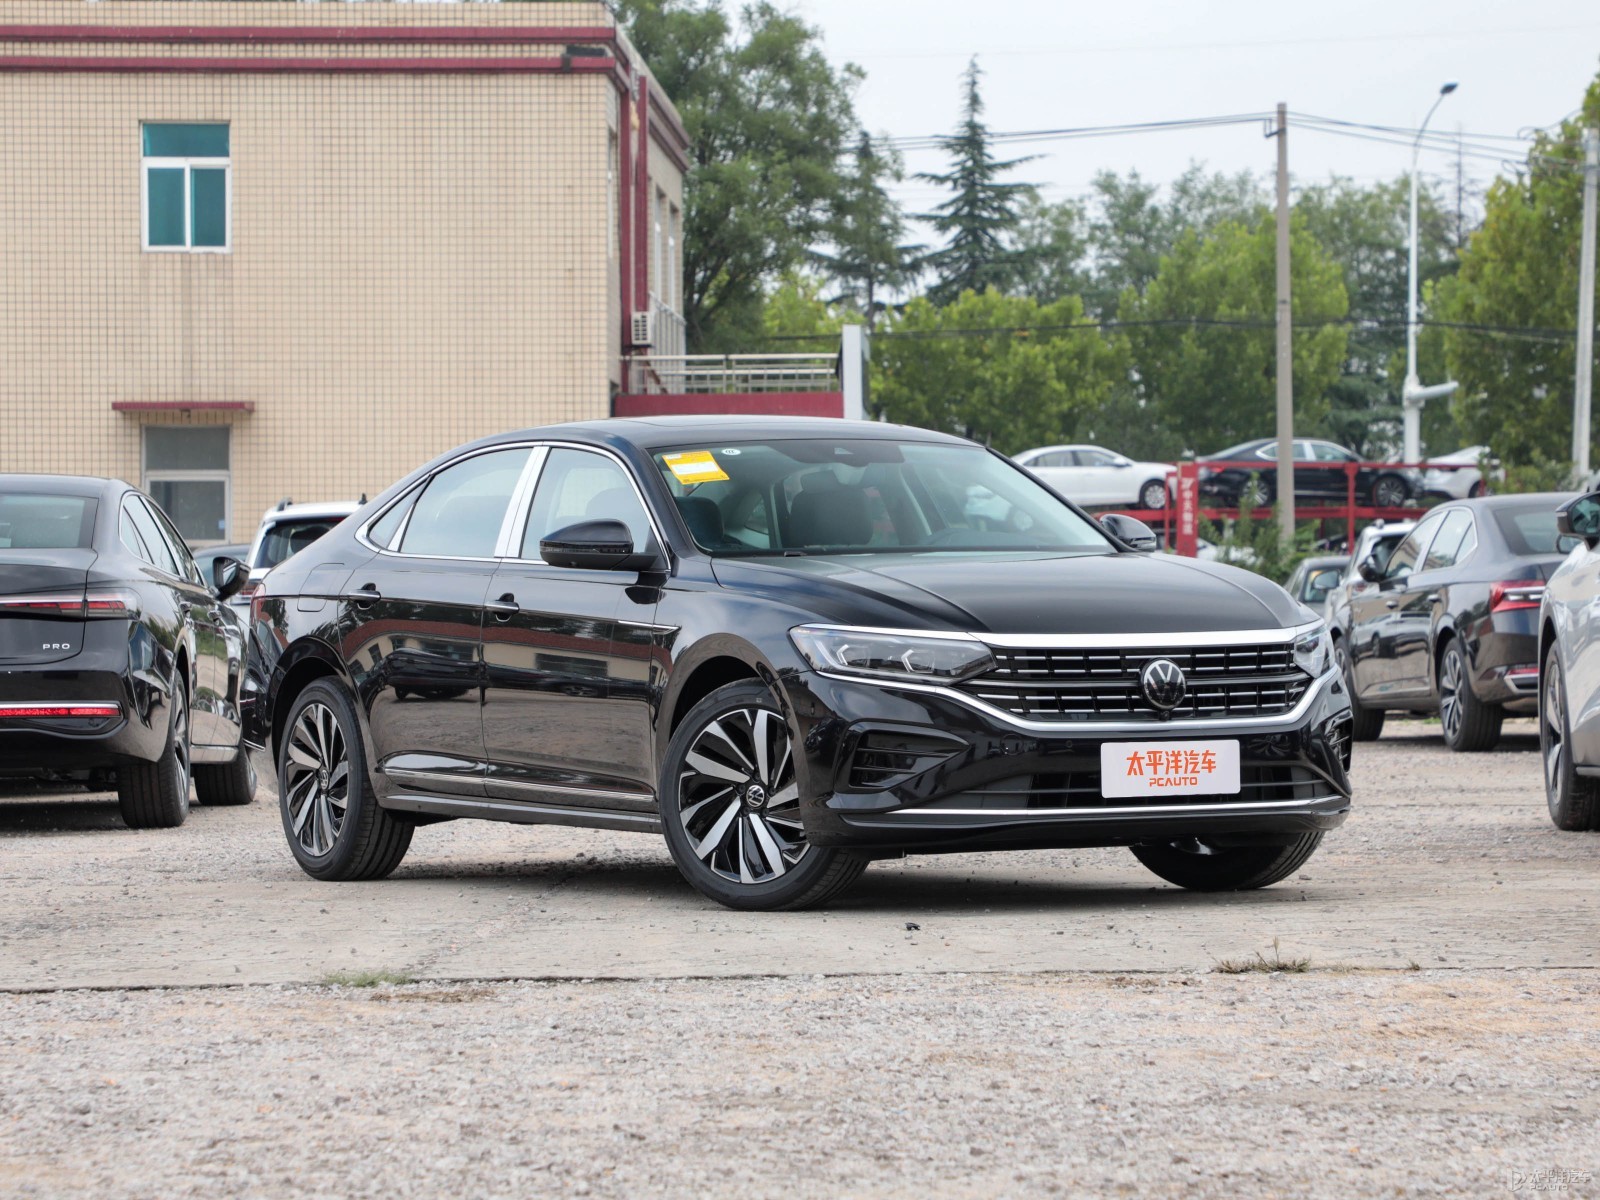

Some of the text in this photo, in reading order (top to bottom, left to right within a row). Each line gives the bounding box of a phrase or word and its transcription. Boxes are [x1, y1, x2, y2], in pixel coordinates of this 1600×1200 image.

[1126, 750, 1217, 775] 太平洋汽车
[1149, 777, 1198, 787] PCAUTO
